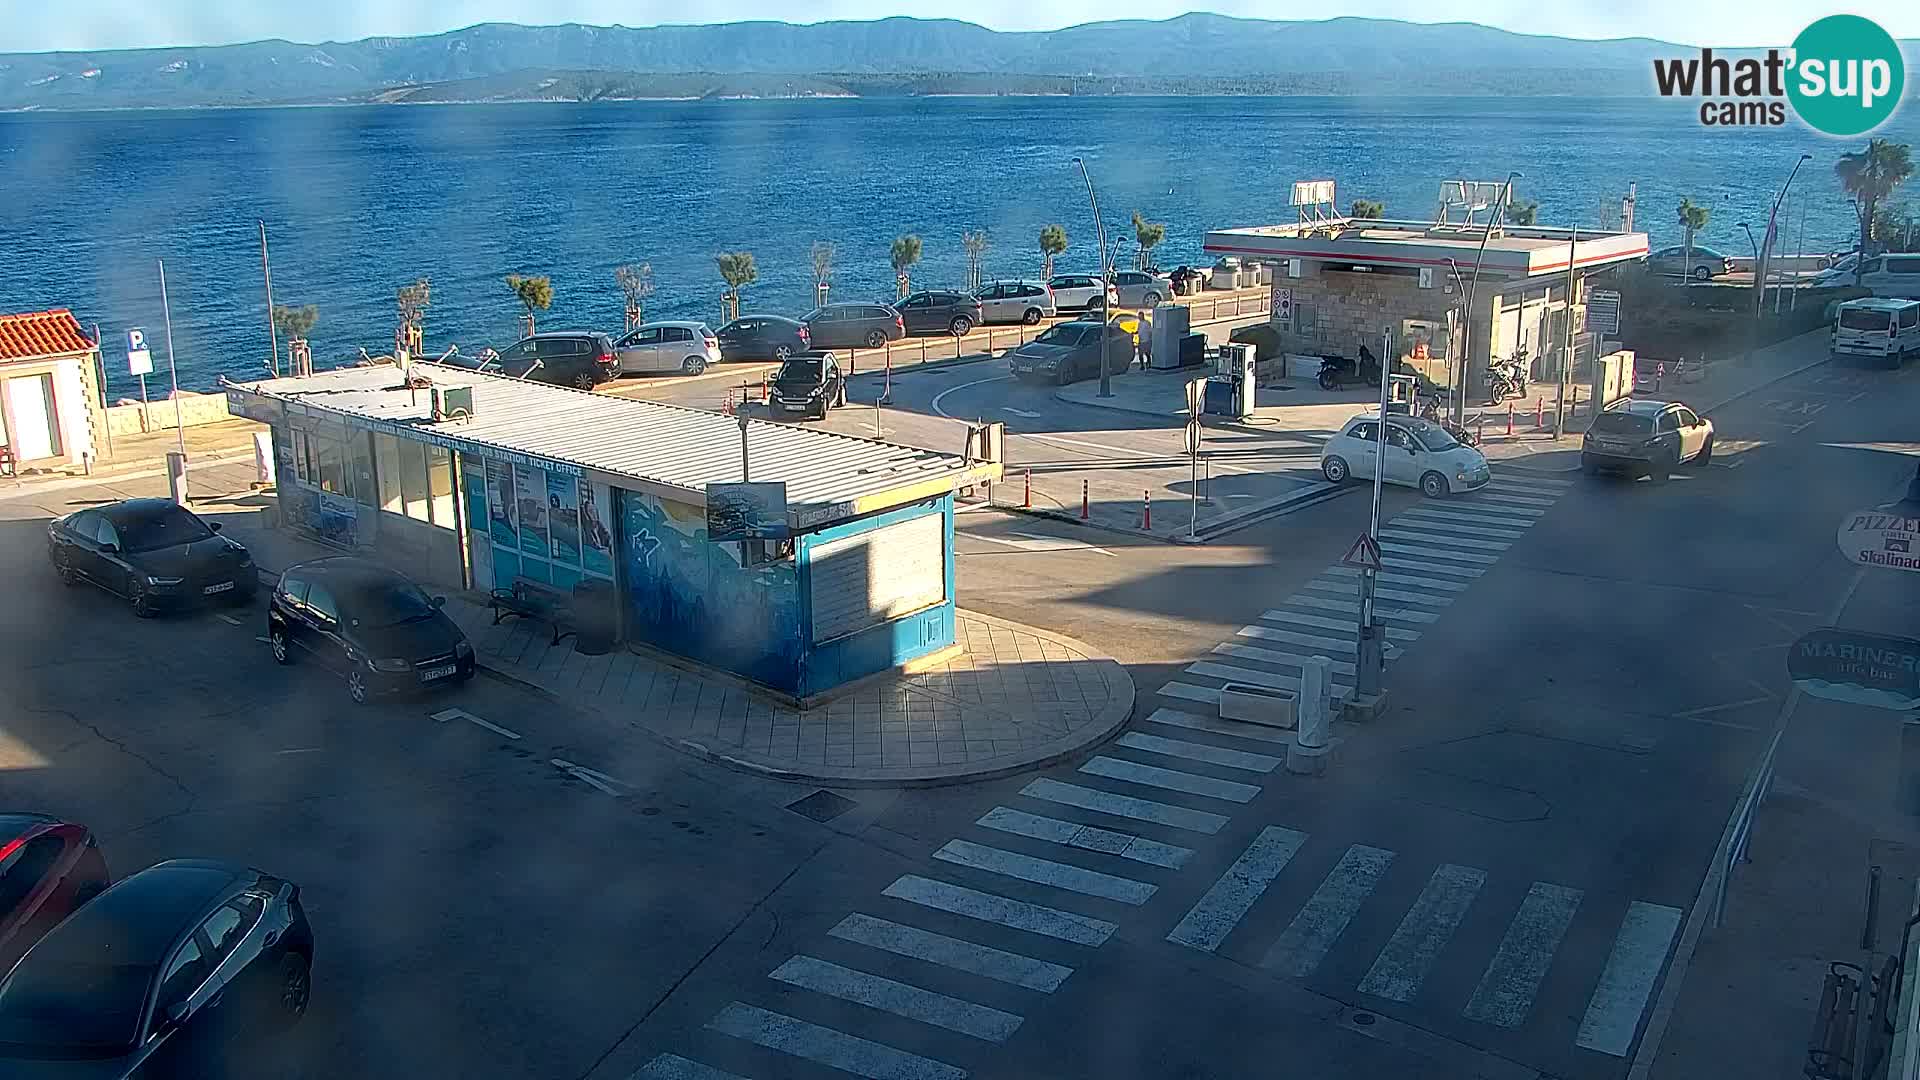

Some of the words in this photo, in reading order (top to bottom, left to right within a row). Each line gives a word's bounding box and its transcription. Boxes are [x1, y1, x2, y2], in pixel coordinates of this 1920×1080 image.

[130, 330, 144, 350] P
[479, 446, 494, 457] BUS
[495, 449, 527, 465] STATION
[529, 457, 554, 471] TICKET
[556, 464, 583, 477] OFFICE
[1847, 514, 1920, 534] PIZZE
